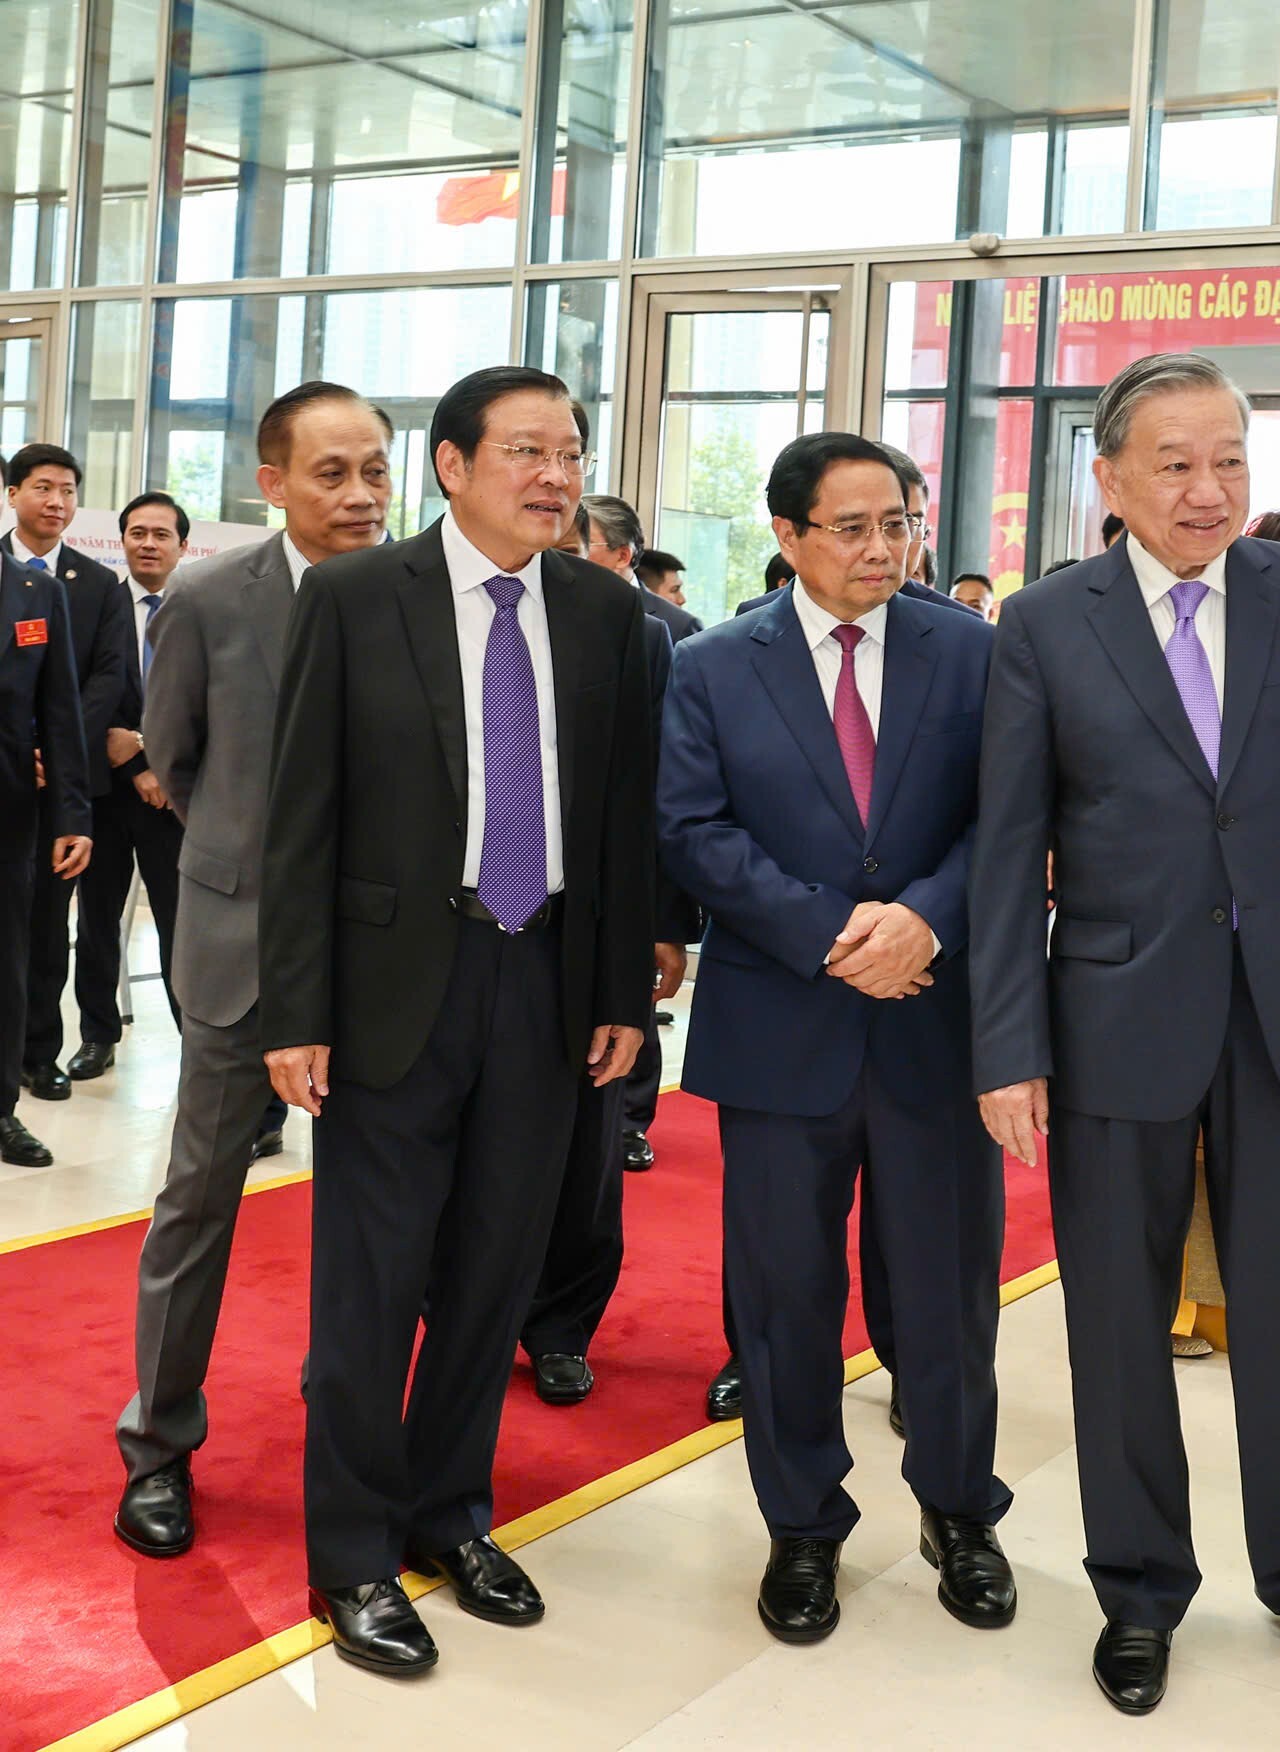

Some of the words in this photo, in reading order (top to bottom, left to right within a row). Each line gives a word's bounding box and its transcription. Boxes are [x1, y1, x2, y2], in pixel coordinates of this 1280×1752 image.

[1003, 282, 1039, 333] LIỆ
[1121, 276, 1193, 321] MỪNG
[1198, 273, 1248, 320] CÁC
